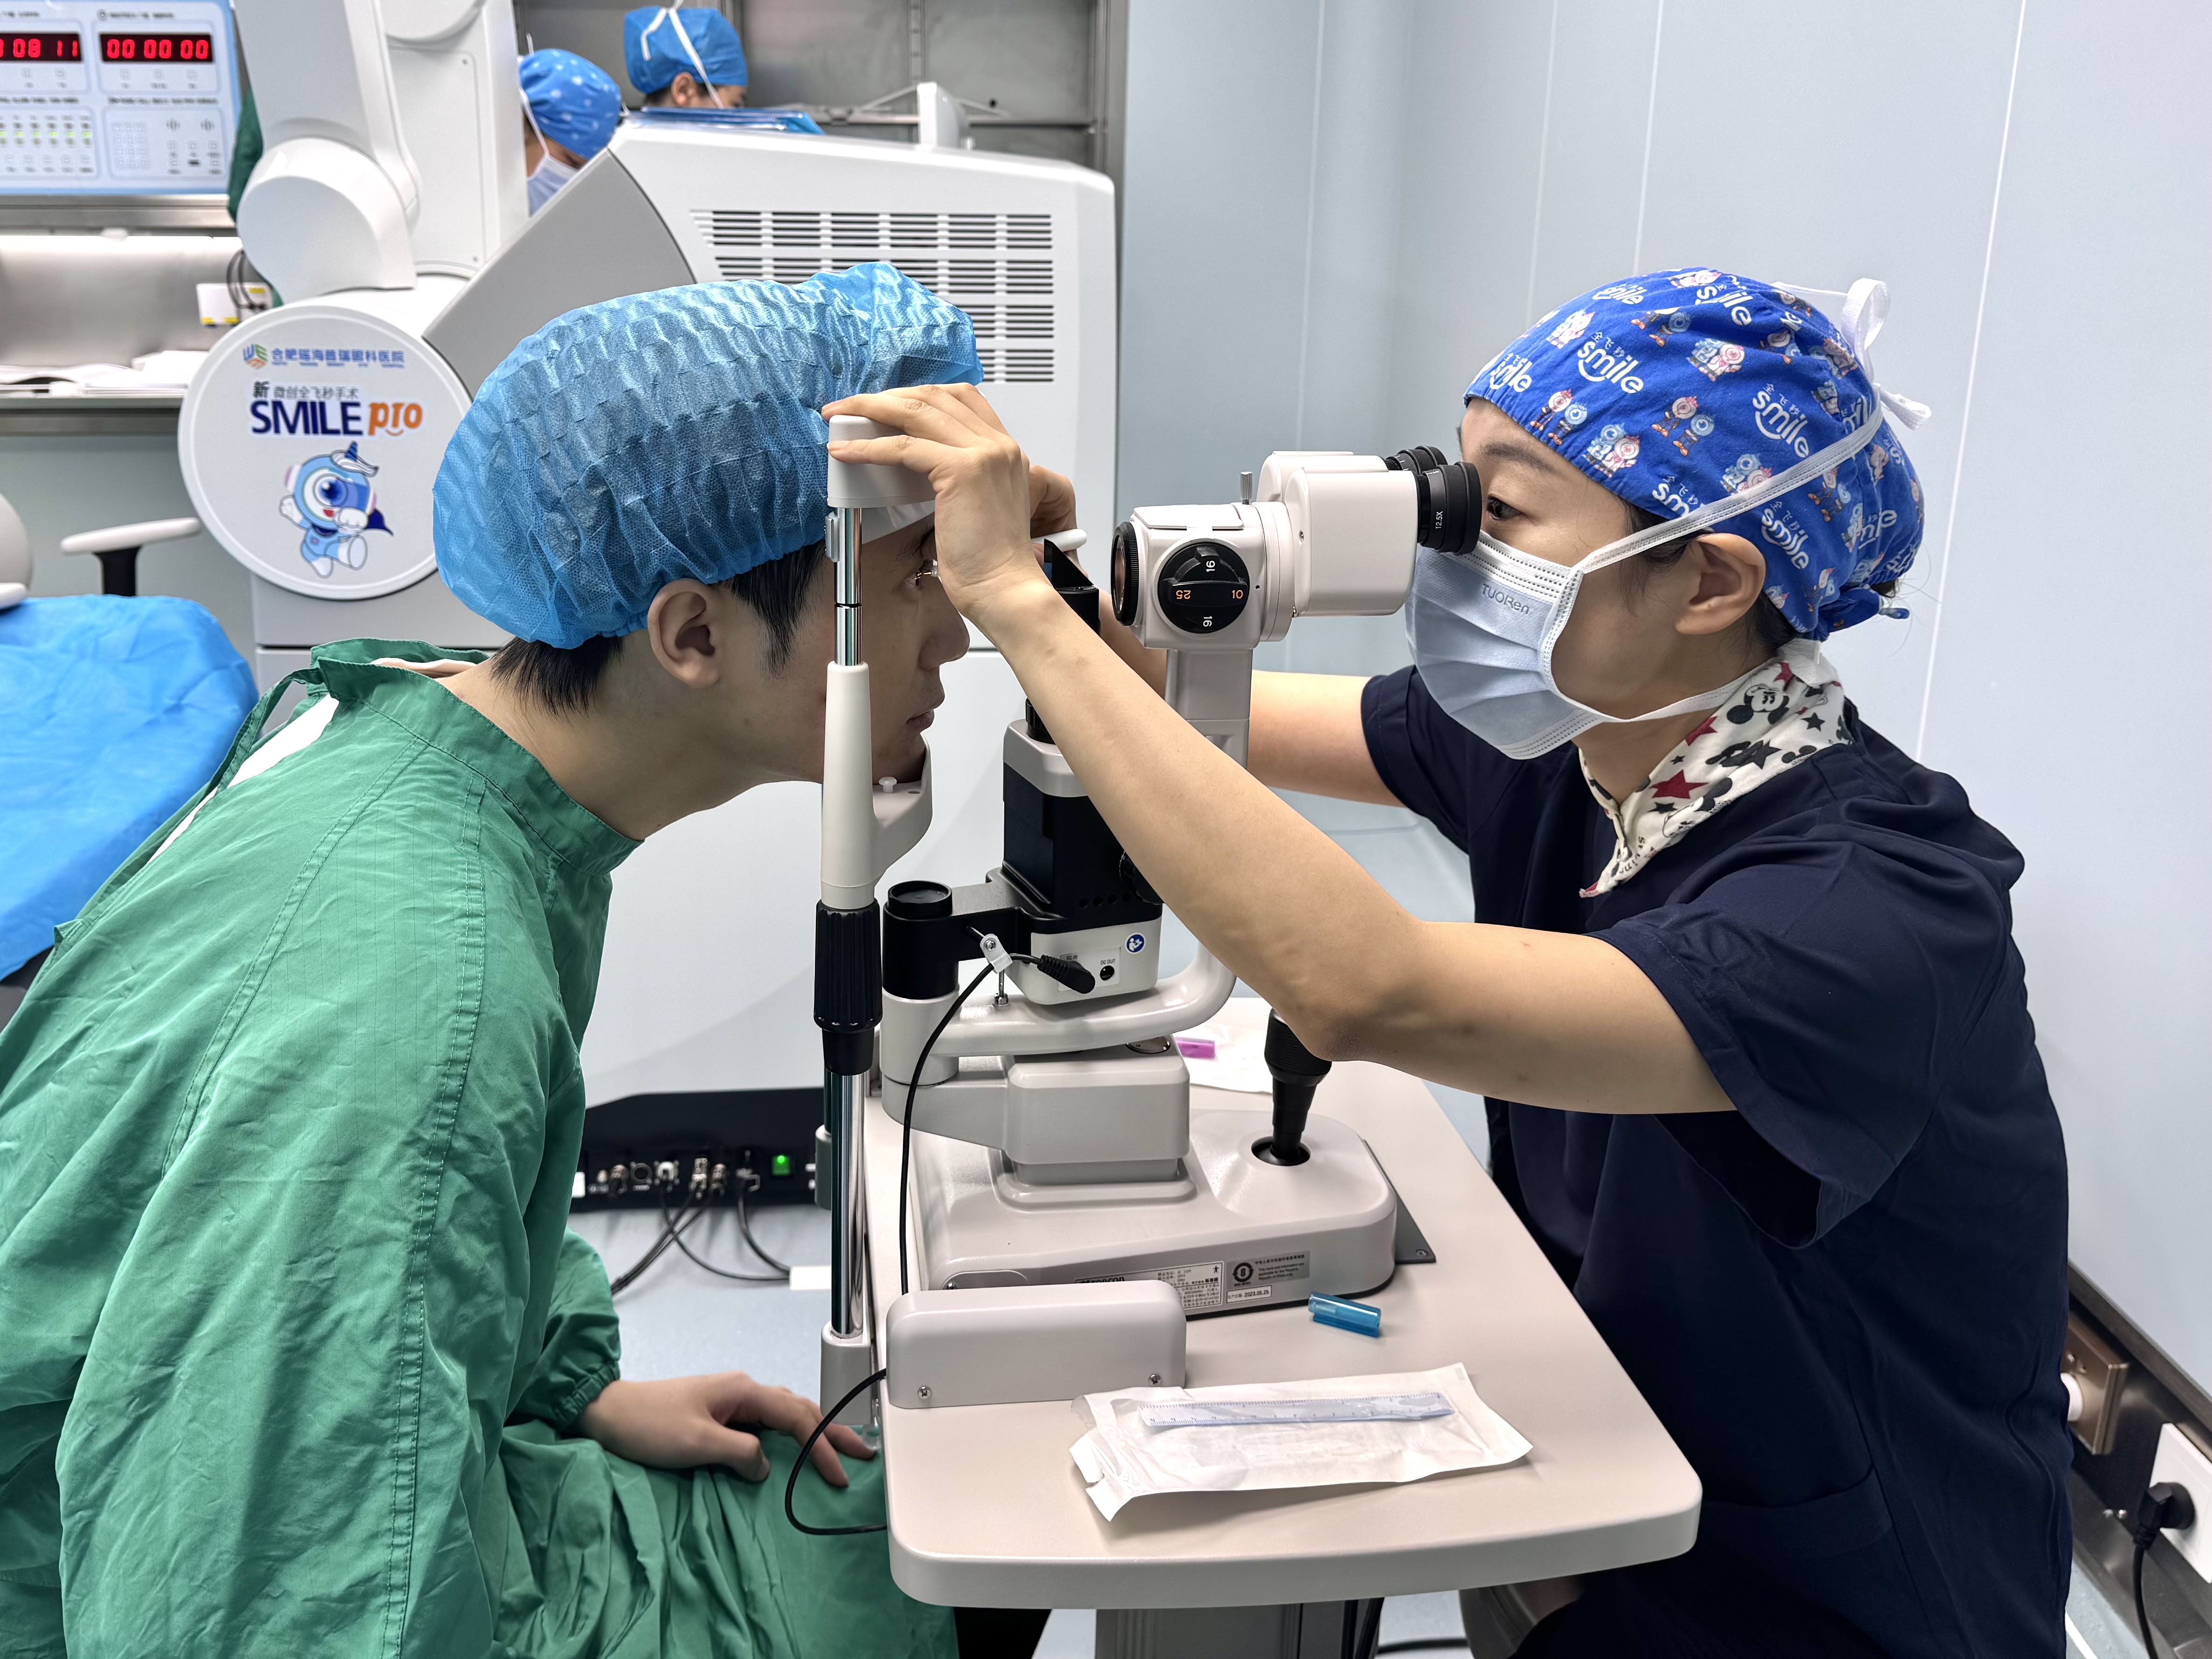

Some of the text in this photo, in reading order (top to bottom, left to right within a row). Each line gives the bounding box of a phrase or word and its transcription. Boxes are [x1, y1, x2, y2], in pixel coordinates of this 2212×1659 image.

[13, 38, 41, 57] 08
[57, 40, 78, 57] 11
[107, 39, 208, 59] 00 00 00
[1591, 332, 1625, 357] 全飞秒
[1577, 341, 1644, 394] smile
[253, 380, 269, 398] 新
[250, 400, 423, 436] SMILE pro
[1752, 391, 1809, 458] smile
[1761, 508, 1809, 569] smile
[1206, 560, 1215, 572] 16
[1176, 590, 1191, 599] 25
[1232, 589, 1243, 599] 10
[1482, 583, 1530, 615] TUORen
[1203, 616, 1212, 627] 16
[1241, 1268, 1246, 1277] 8
